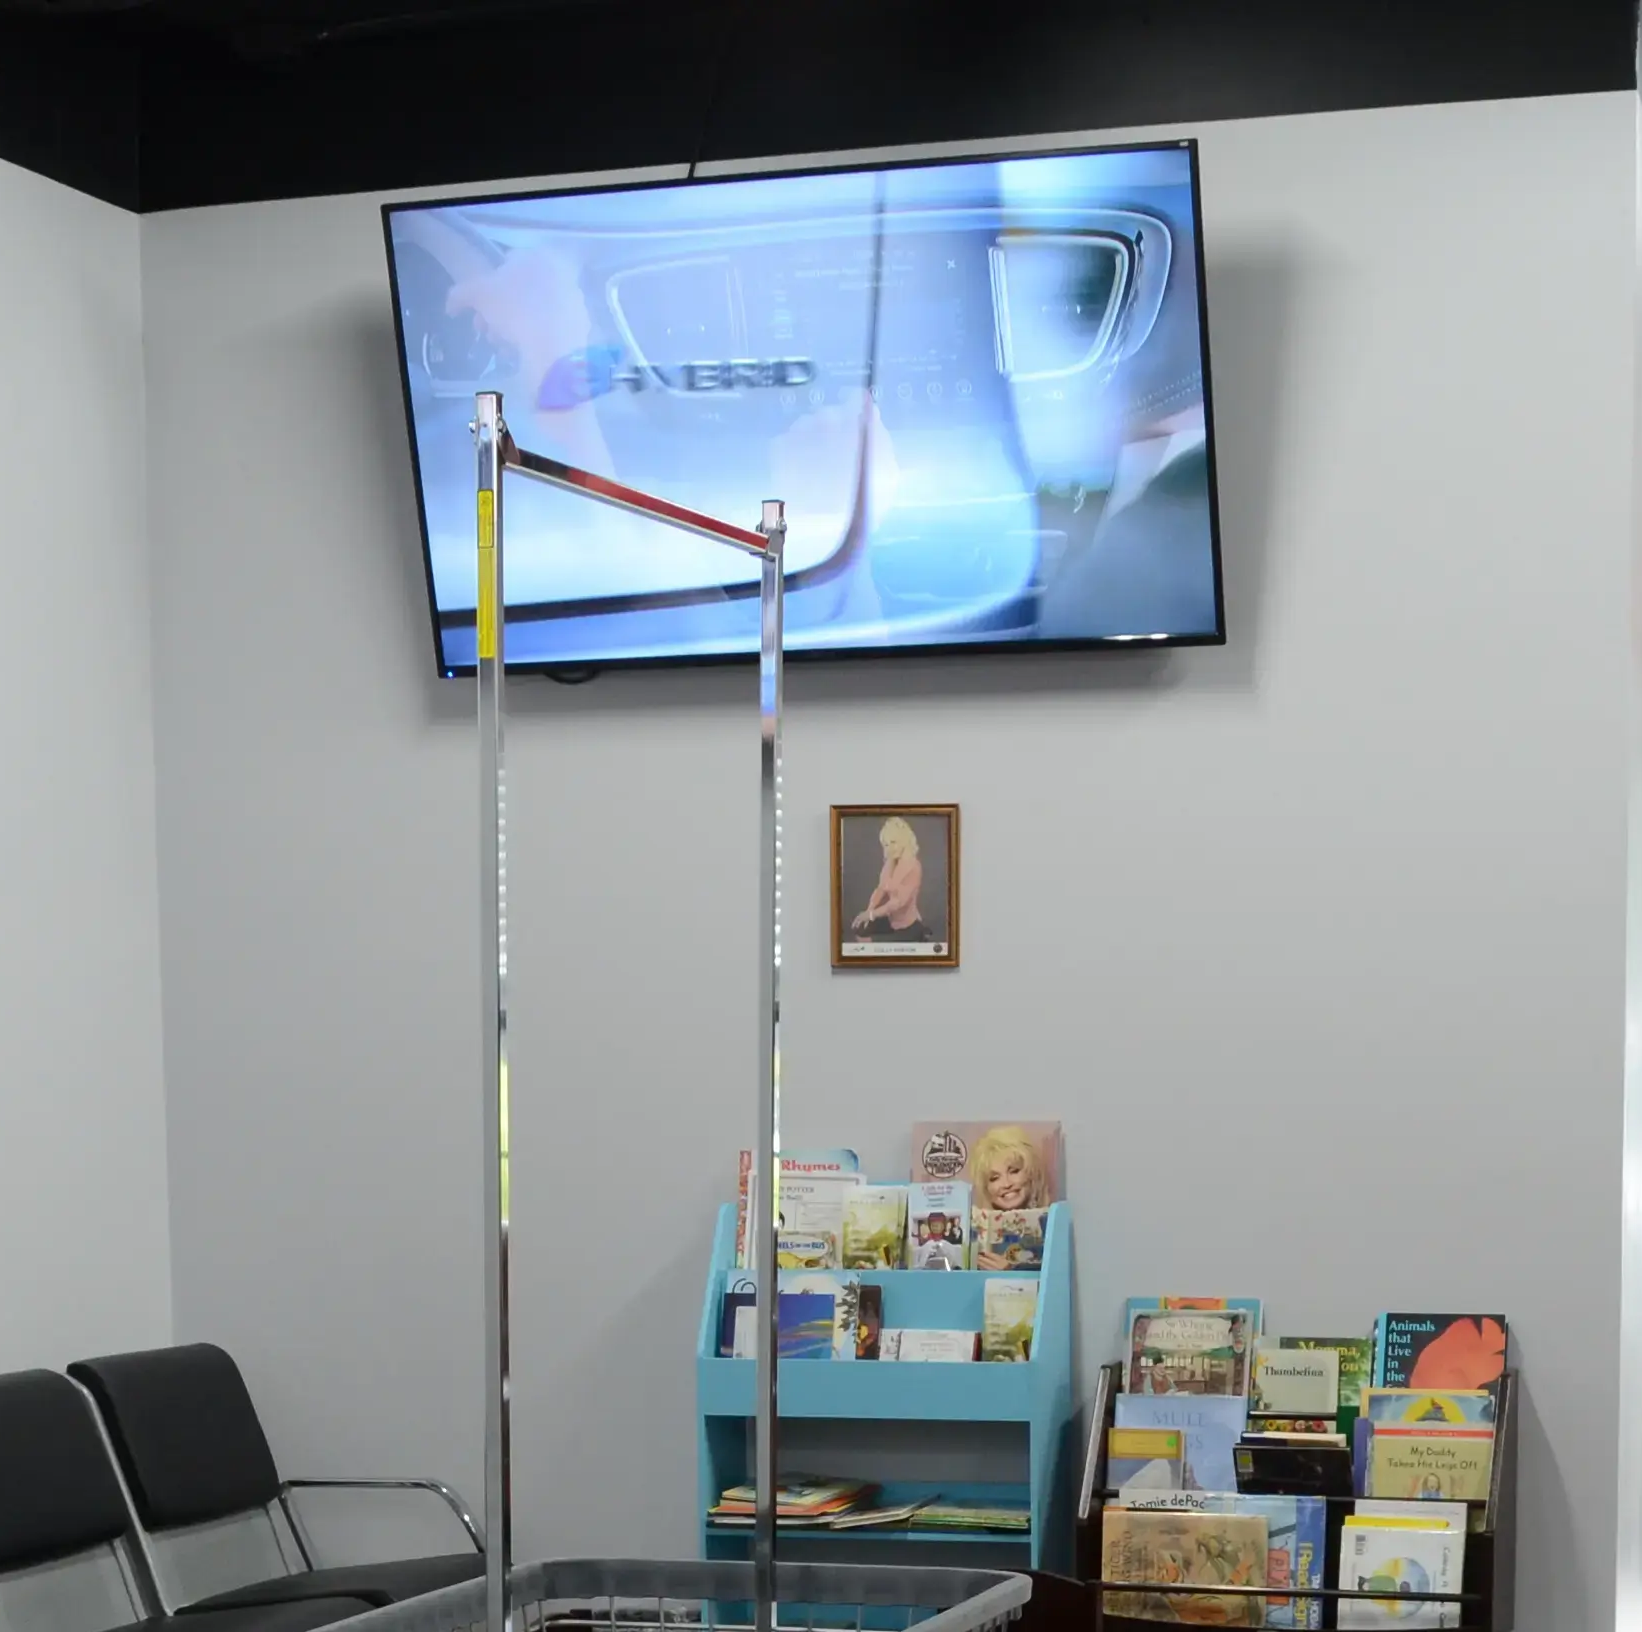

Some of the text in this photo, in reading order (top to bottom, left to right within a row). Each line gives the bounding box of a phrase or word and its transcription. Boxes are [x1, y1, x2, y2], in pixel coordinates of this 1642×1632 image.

[1388, 1320, 1436, 1332] Animals
[1388, 1332, 1411, 1343] that
[1387, 1345, 1412, 1356] Live
[1387, 1358, 1399, 1369] in
[1264, 1366, 1325, 1377] Thumbelina
[1386, 1370, 1405, 1382] the
[1410, 1447, 1424, 1457] My
